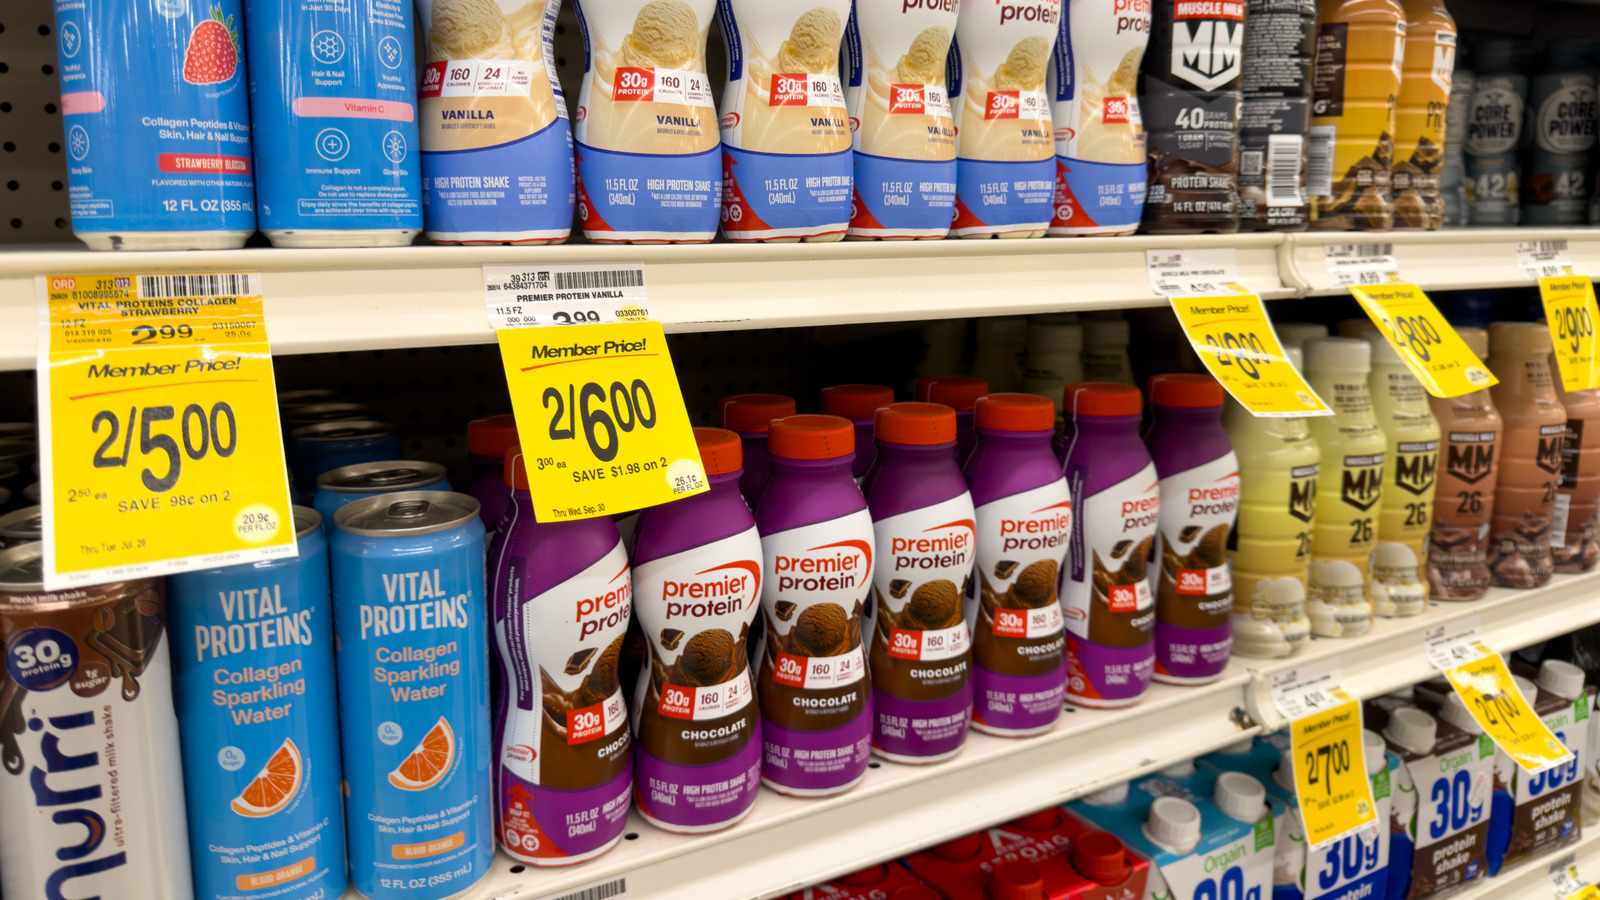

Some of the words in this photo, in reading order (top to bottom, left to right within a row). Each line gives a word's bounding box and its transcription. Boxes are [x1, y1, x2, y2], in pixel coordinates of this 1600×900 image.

[1000, 5, 1058, 25] protein
[1177, 2, 1221, 16] MUSCLE
[1171, 21, 1244, 92] MM
[450, 68, 470, 81] 160
[483, 67, 501, 80] 24
[660, 76, 680, 88] 160
[812, 81, 827, 92] 160
[344, 103, 377, 113] Vitamin
[378, 105, 385, 113] C
[441, 110, 495, 120] VANILLA
[1175, 107, 1204, 129] 40
[1204, 111, 1228, 120] GRAMS
[1475, 104, 1510, 122] CORE
[1557, 101, 1596, 119] CORE
[142, 116, 189, 128] Collagen
[190, 118, 228, 130] Peptides
[656, 115, 702, 128] VANILLA
[1469, 120, 1515, 140] POWER
[1550, 119, 1598, 137] POWER
[159, 130, 185, 141] Skin,
[186, 130, 205, 140] Hair
[207, 132, 213, 140] &
[214, 133, 229, 141] Nail
[175, 157, 224, 169] STRAWBERRY
[333, 168, 361, 176] Support
[434, 176, 449, 189] HIGH
[450, 176, 482, 189] PROTEIN
[483, 176, 510, 189] SHAKE
[605, 178, 618, 191] 11.5
[619, 178, 628, 191] FL
[628, 178, 639, 191] OZ
[1171, 177, 1208, 189] PROTEIN
[1208, 176, 1231, 189] SHAKE
[1475, 173, 1505, 198] 42
[1556, 172, 1586, 197] 42
[162, 200, 178, 211] 12
[181, 200, 198, 211] FL
[201, 200, 219, 211] OZ
[221, 200, 241, 213] (355
[608, 192, 636, 206] (340mL)
[1173, 202, 1183, 212] 14
[1184, 202, 1195, 212] FL
[1195, 201, 1206, 212] OZ
[53, 279, 75, 290] ORD
[96, 280, 113, 290] 313
[115, 278, 130, 288] 012
[511, 274, 521, 283] 39
[521, 272, 535, 282] 313
[78, 301, 112, 311] VITAL
[116, 299, 174, 309] PROTEINS
[178, 297, 237, 307] COLLAGEN
[516, 293, 554, 302] PREMIER
[556, 291, 590, 301] PROTEIN
[592, 290, 624, 299] VANILLA
[121, 307, 199, 317] STRAWBERRY
[496, 307, 512, 316] 11.5
[512, 306, 523, 315] FZ
[615, 308, 649, 318] 03300761
[1190, 305, 1226, 315] Member
[1227, 304, 1250, 314] Price!
[61, 319, 72, 329] 12
[74, 319, 86, 328] FZ
[212, 321, 257, 330] 03150067
[131, 324, 193, 345] 299
[531, 342, 601, 360] Member
[604, 337, 647, 355] Price!
[88, 363, 181, 380] Member
[185, 356, 242, 374] Price!
[536, 457, 554, 471] 300
[556, 461, 567, 469] ea
[572, 467, 606, 483] SAVE
[610, 461, 641, 478] $1.98
[643, 461, 658, 472] on
[659, 457, 668, 468] 2
[674, 474, 697, 487] 26.1¢
[67, 488, 91, 503] 250
[95, 492, 108, 501] ea
[118, 497, 161, 514] SAVE
[169, 494, 196, 508] 98¢
[200, 493, 219, 505] on
[222, 490, 231, 502] 2
[1456, 490, 1482, 514] 26
[242, 512, 269, 525] 20.9¢
[552, 508, 567, 519] Thru
[567, 506, 583, 517] Wed.
[584, 505, 597, 516] Sep.
[597, 503, 606, 513] 30
[1403, 502, 1427, 527] 26
[238, 524, 254, 534] PER
[1000, 513, 1071, 537] premier
[1350, 518, 1373, 544] 26
[892, 531, 970, 556] premier
[1003, 530, 1067, 552] protein
[774, 552, 860, 575] premier
[895, 551, 966, 571] protein
[382, 568, 446, 603] VITAL
[662, 574, 748, 601] premier
[779, 572, 855, 592] protein
[218, 584, 288, 622] VITAL
[666, 595, 742, 620] protein
[359, 593, 468, 640] PROTEINS
[194, 608, 312, 662] PROTEINS
[13, 639, 73, 669] 30g
[375, 641, 457, 663] Collagen
[21, 662, 60, 678] protein
[213, 658, 302, 685] Collagen
[374, 659, 460, 687] Sparkling
[909, 661, 967, 678] CHOCOLATE
[212, 678, 306, 709] Sparkling
[390, 683, 448, 703] Water
[701, 691, 719, 705] 160
[792, 691, 857, 708] CHOCOLATE
[102, 704, 114, 739] shake
[231, 702, 292, 726] Water
[681, 717, 747, 740] CHOCOLATE
[1303, 718, 1331, 735] Member
[104, 741, 116, 766] milk
[1439, 749, 1474, 773] Orgain
[109, 769, 125, 847] ultra-filtered
[367, 812, 400, 825] Collagen
[401, 812, 439, 825] Peptides
[439, 809, 447, 818] &
[446, 799, 473, 816] Vitamin
[1531, 791, 1572, 821] protein
[378, 824, 398, 834] Skin,
[398, 823, 415, 833] Hair
[416, 823, 423, 832] &
[423, 820, 440, 831] Nail
[440, 809, 471, 827] Support
[1534, 808, 1566, 832] shake
[404, 845, 427, 856] BLOOD
[428, 838, 454, 853] ORANGE
[1203, 841, 1247, 873] Orgain
[1432, 832, 1477, 866] protein
[1435, 850, 1471, 876] shake
